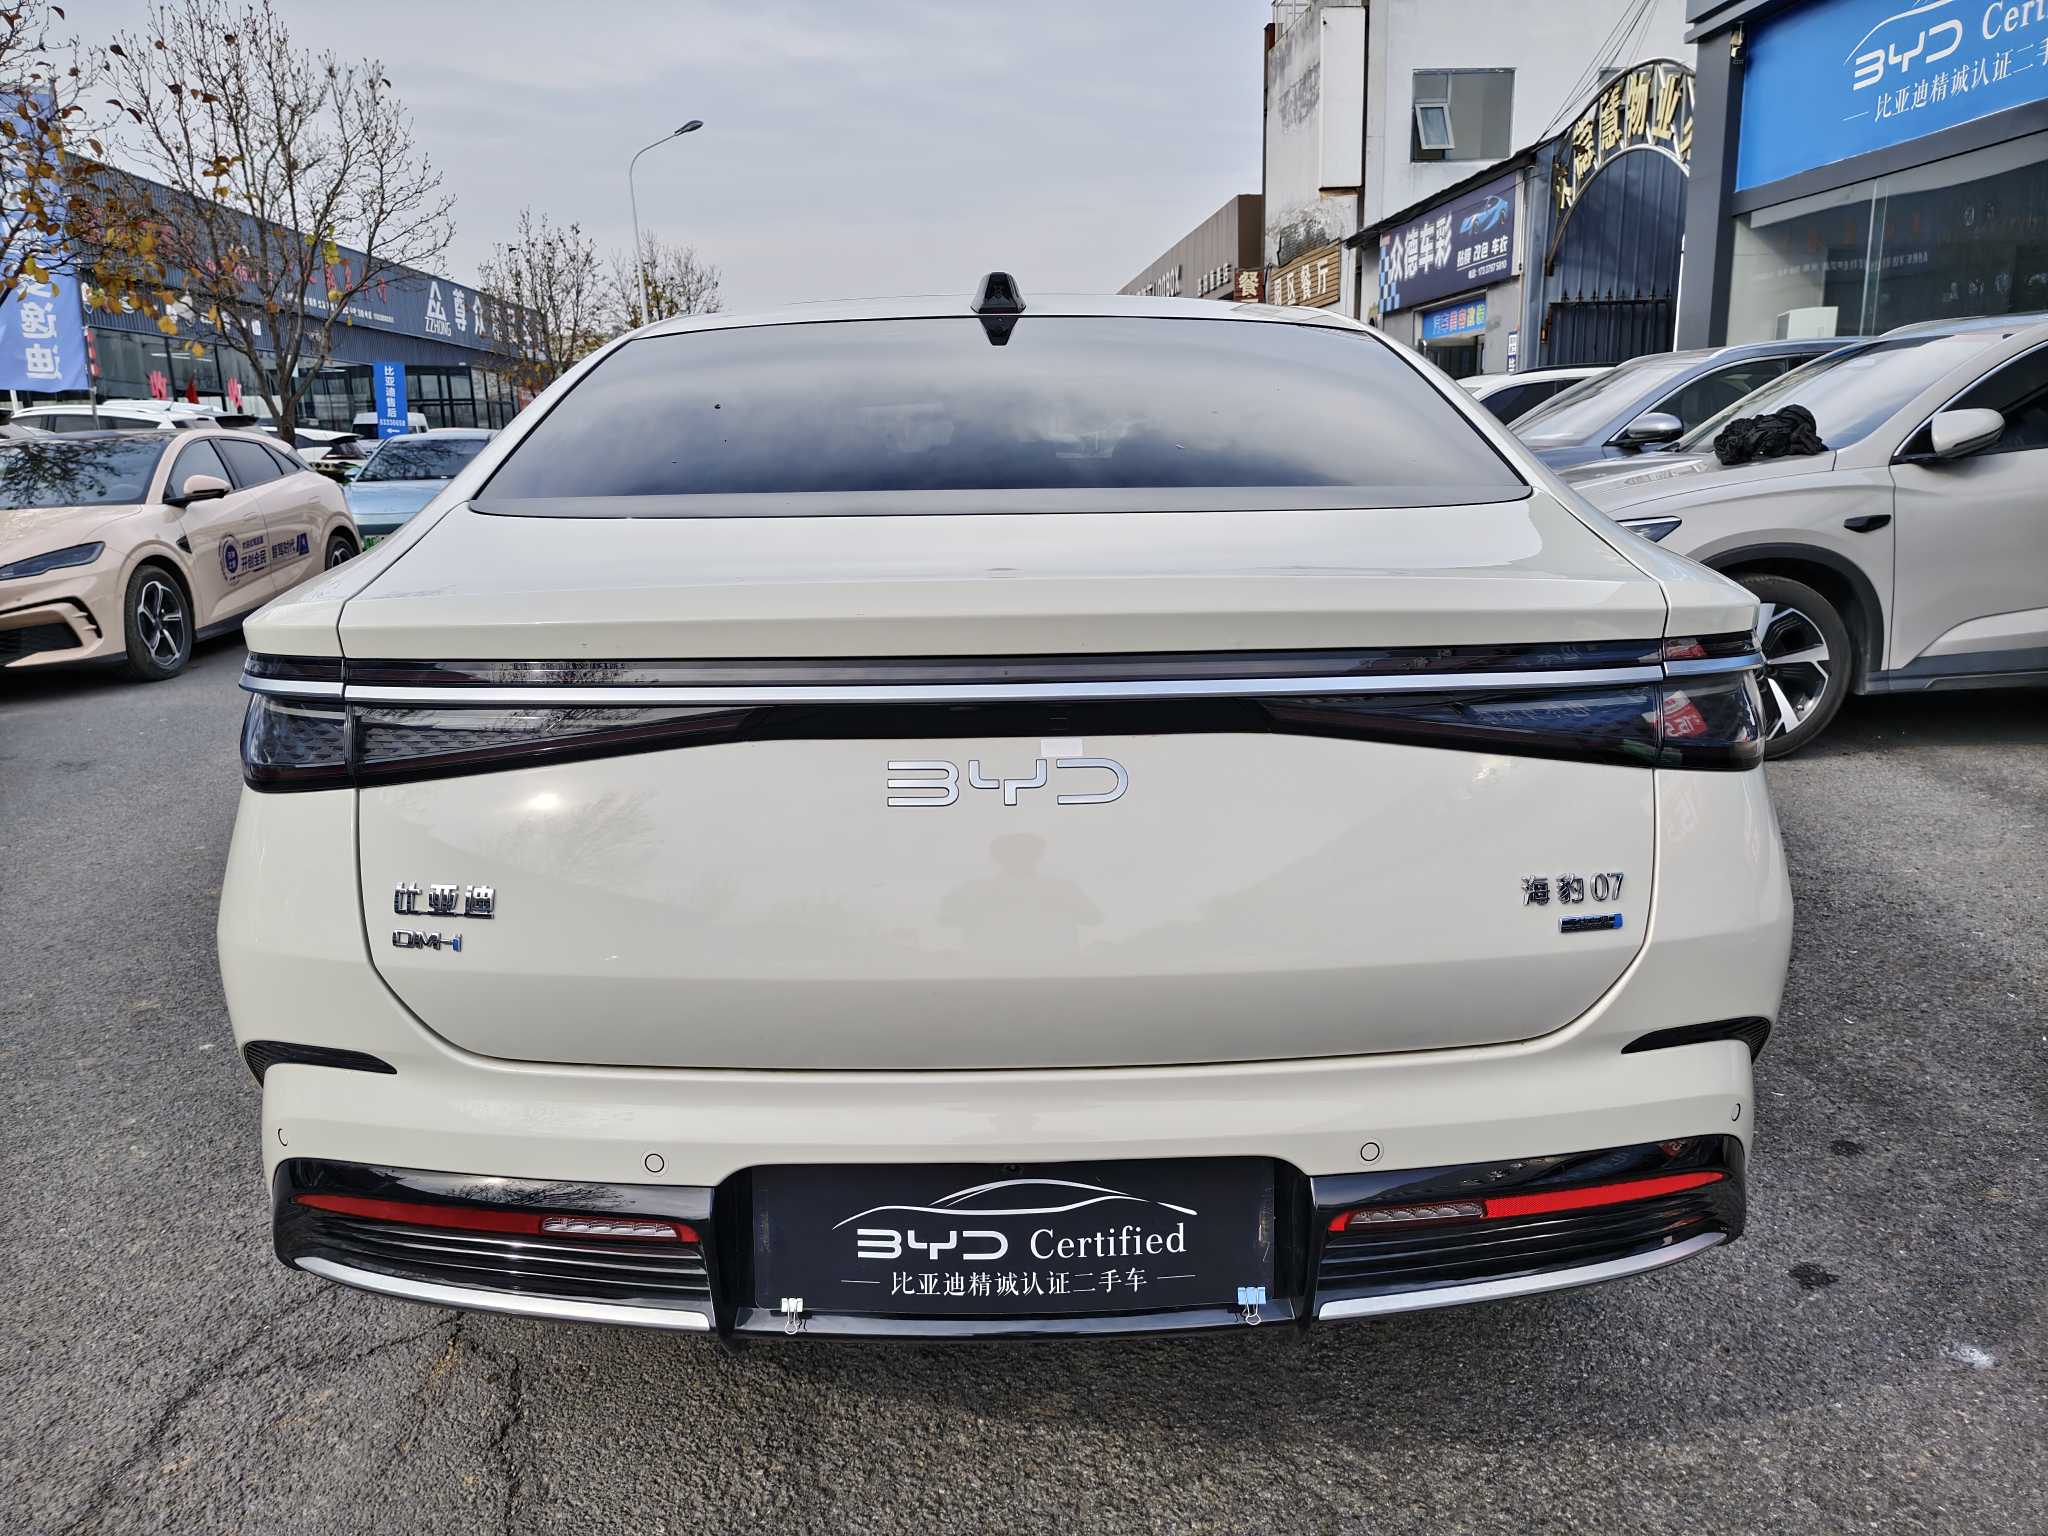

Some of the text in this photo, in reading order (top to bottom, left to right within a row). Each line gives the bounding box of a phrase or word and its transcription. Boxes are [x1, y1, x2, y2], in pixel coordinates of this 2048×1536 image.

[1853, 0, 2048, 91] BYD Cert
[1238, 271, 1259, 302] 餐
[888, 757, 1128, 807] BYD
[394, 881, 495, 918] 比亚迪
[857, 1222, 1187, 1260] BYD Certified
[890, 1267, 1147, 1297] 比亚迪精诚认证二手车
